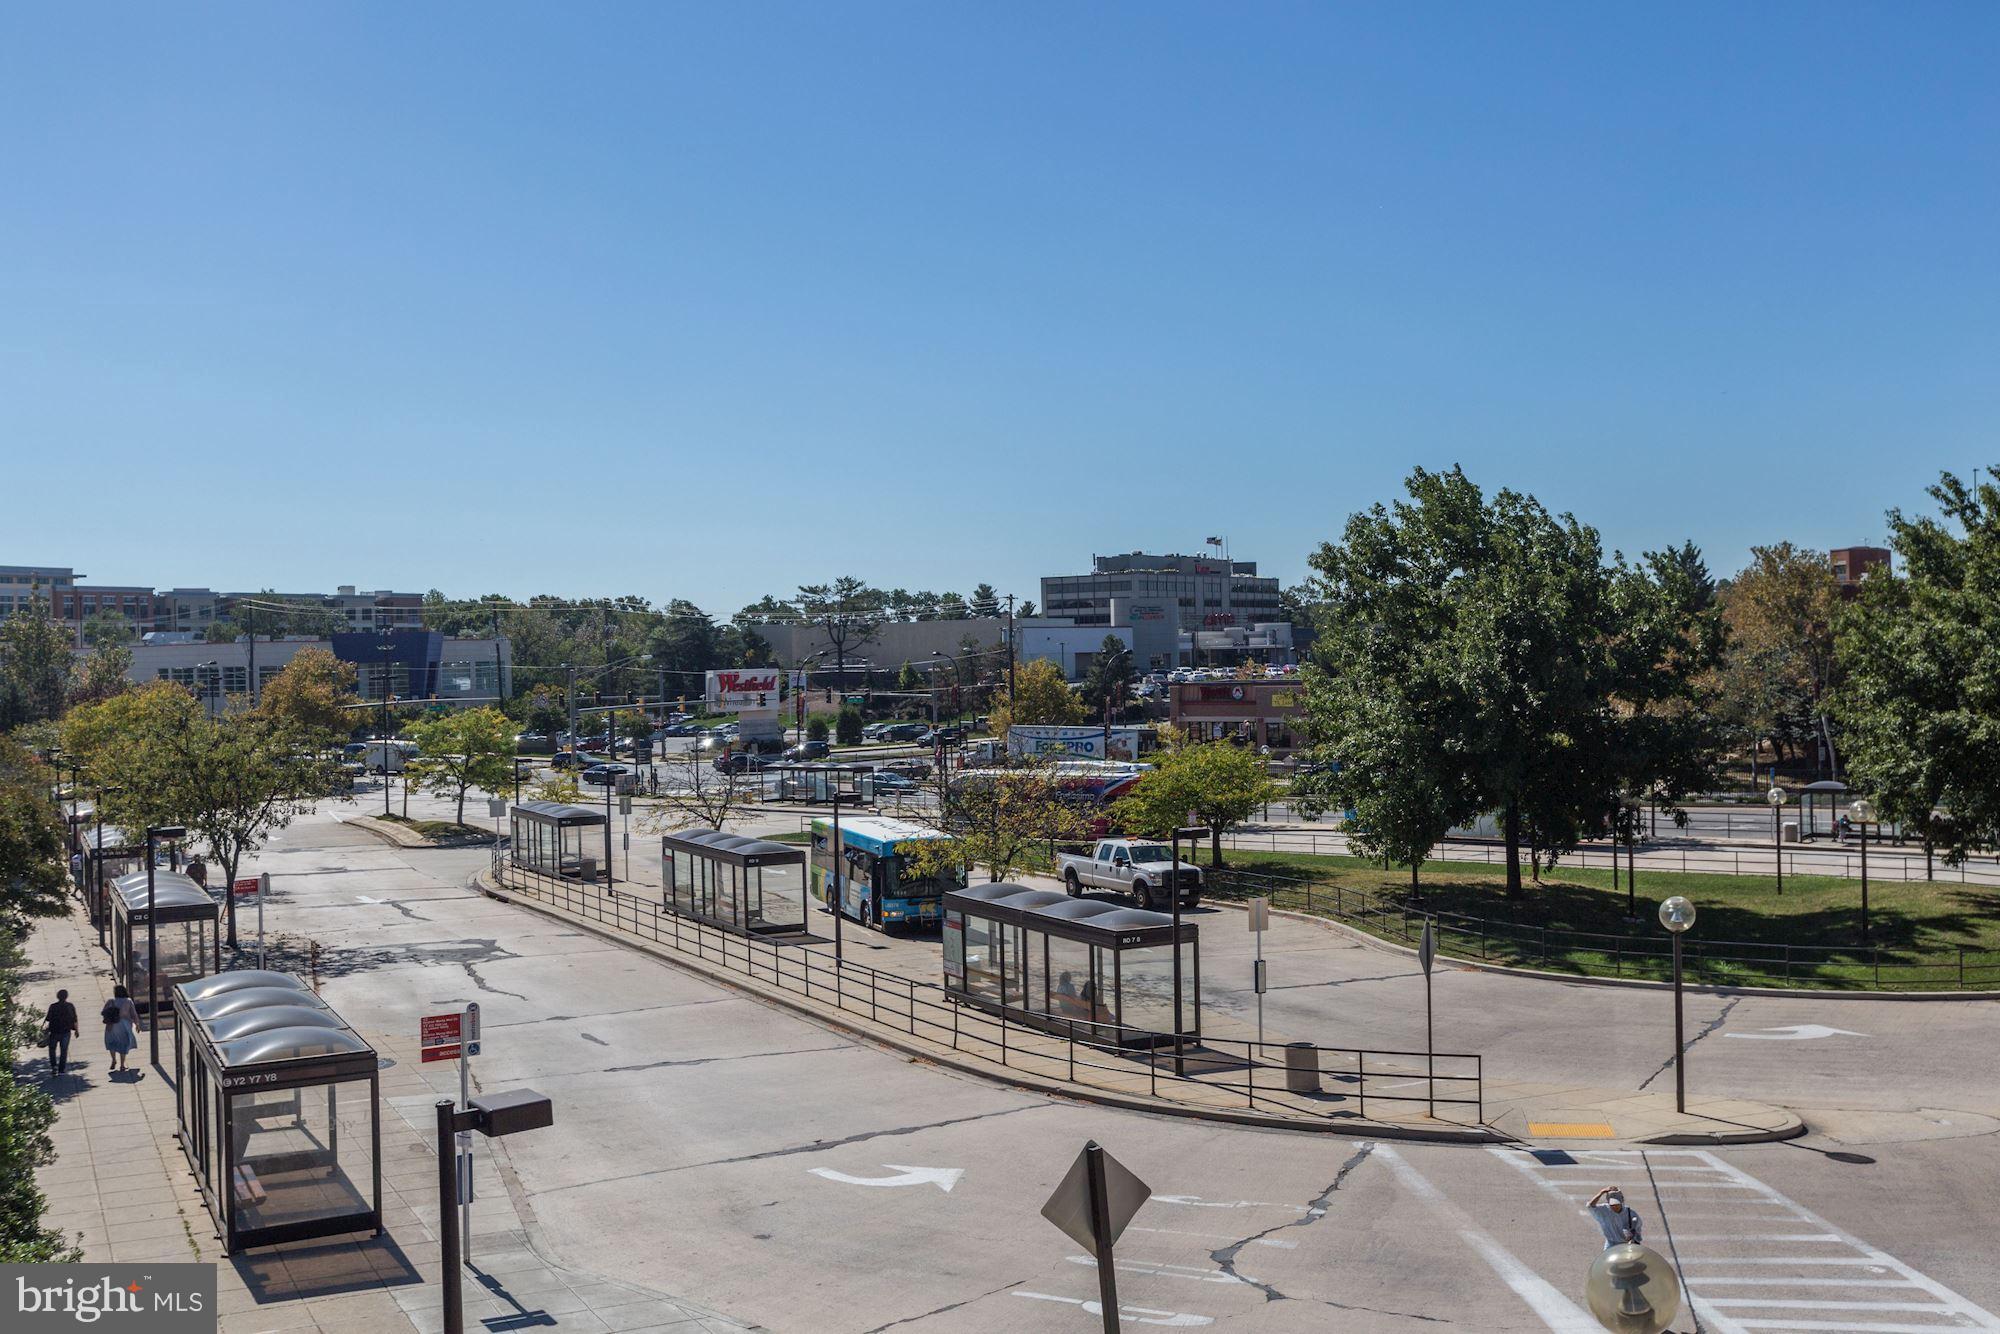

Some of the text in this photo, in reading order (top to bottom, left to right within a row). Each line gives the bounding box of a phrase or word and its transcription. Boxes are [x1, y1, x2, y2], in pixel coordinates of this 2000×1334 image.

[717, 672, 777, 693] Westfield
[233, 1077, 246, 1085] Y2
[248, 1075, 261, 1084] Y7
[264, 1073, 278, 1082] Y8
